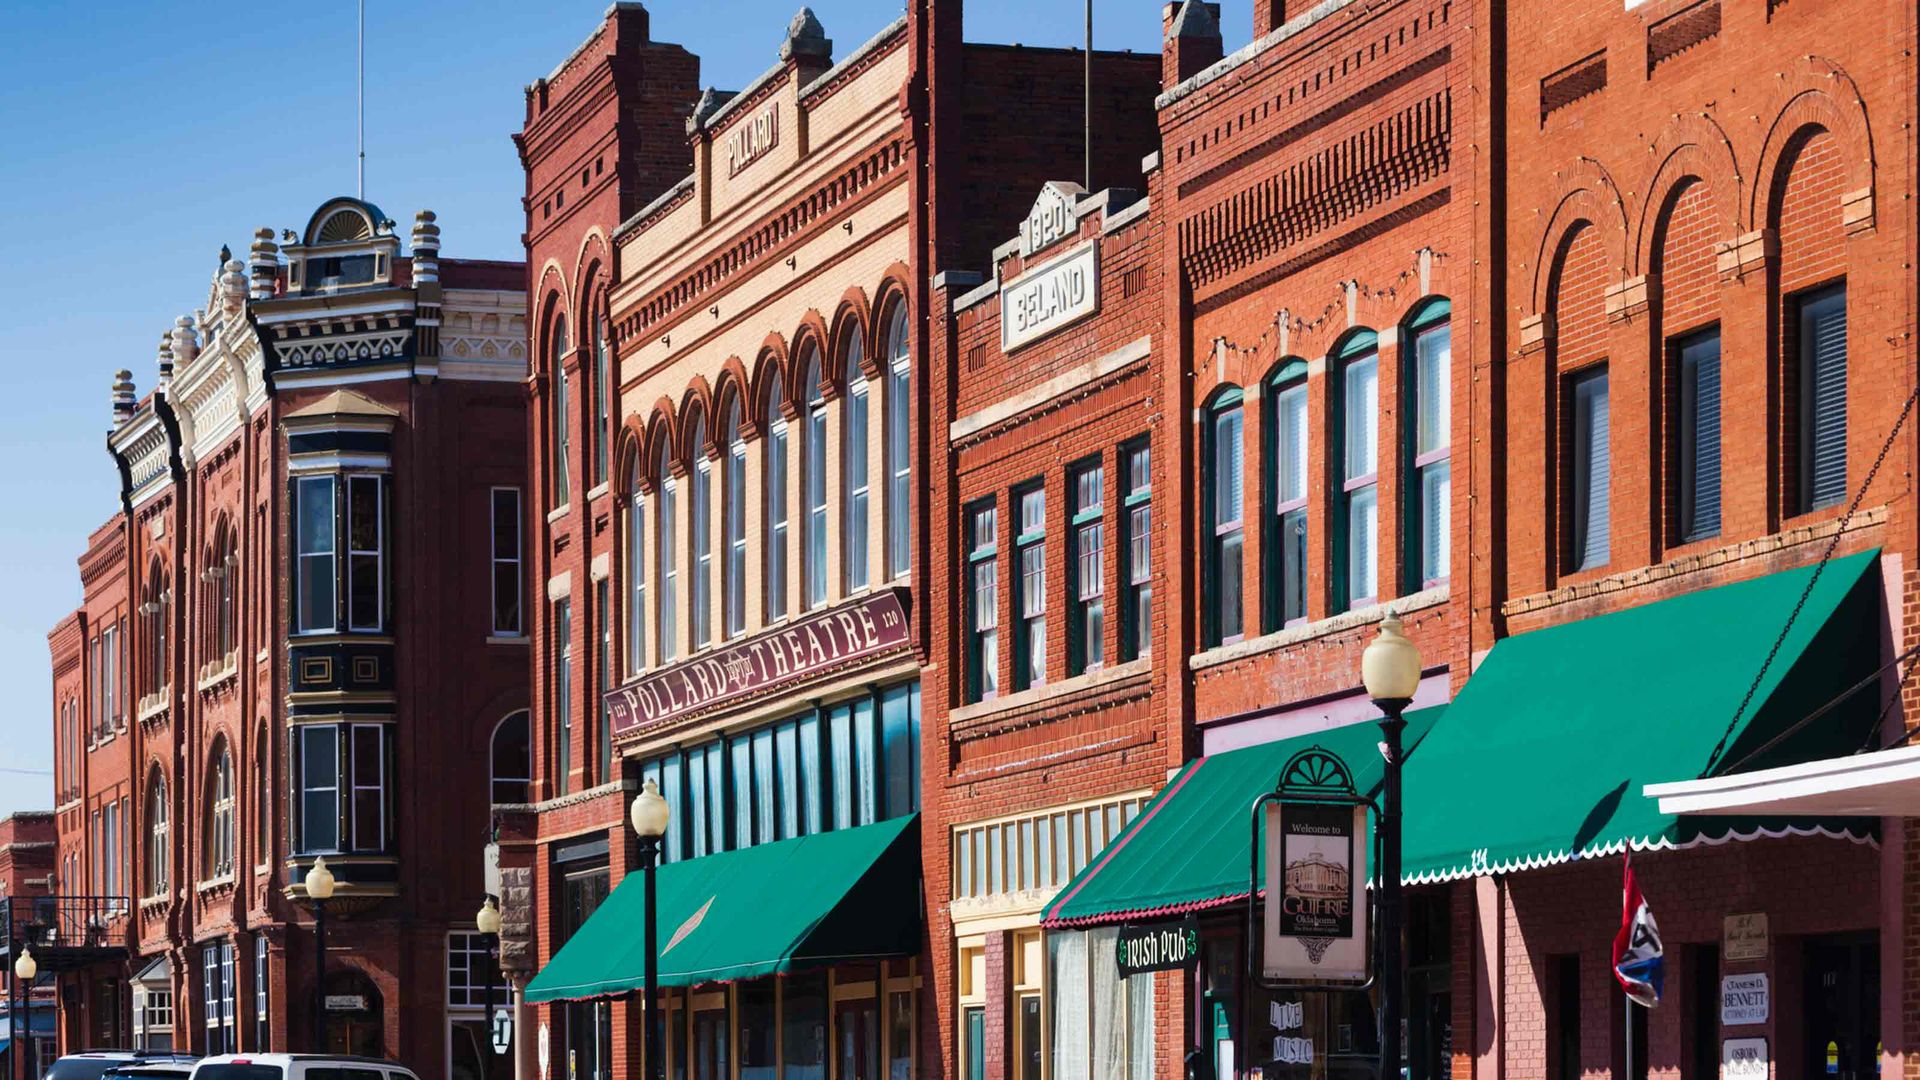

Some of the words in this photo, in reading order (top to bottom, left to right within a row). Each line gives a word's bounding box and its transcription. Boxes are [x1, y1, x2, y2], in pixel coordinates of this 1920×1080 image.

[727, 110, 773, 176] POLLARD
[1027, 199, 1067, 252] 1920
[1018, 264, 1085, 332] BELAND
[623, 658, 727, 724] POLLARD
[751, 605, 879, 682] THEATRE
[882, 610, 899, 629] 120
[1292, 823, 1331, 834] Welcome
[1332, 826, 1341, 834] to
[1283, 896, 1351, 918] GUTHRIE
[1727, 980, 1755, 990] JAMES
[1724, 991, 1766, 1007] BENNETT
[1272, 1003, 1300, 1028] LIVE
[1275, 1039, 1312, 1062] MUSIC
[1732, 1048, 1758, 1059] OSBORN
